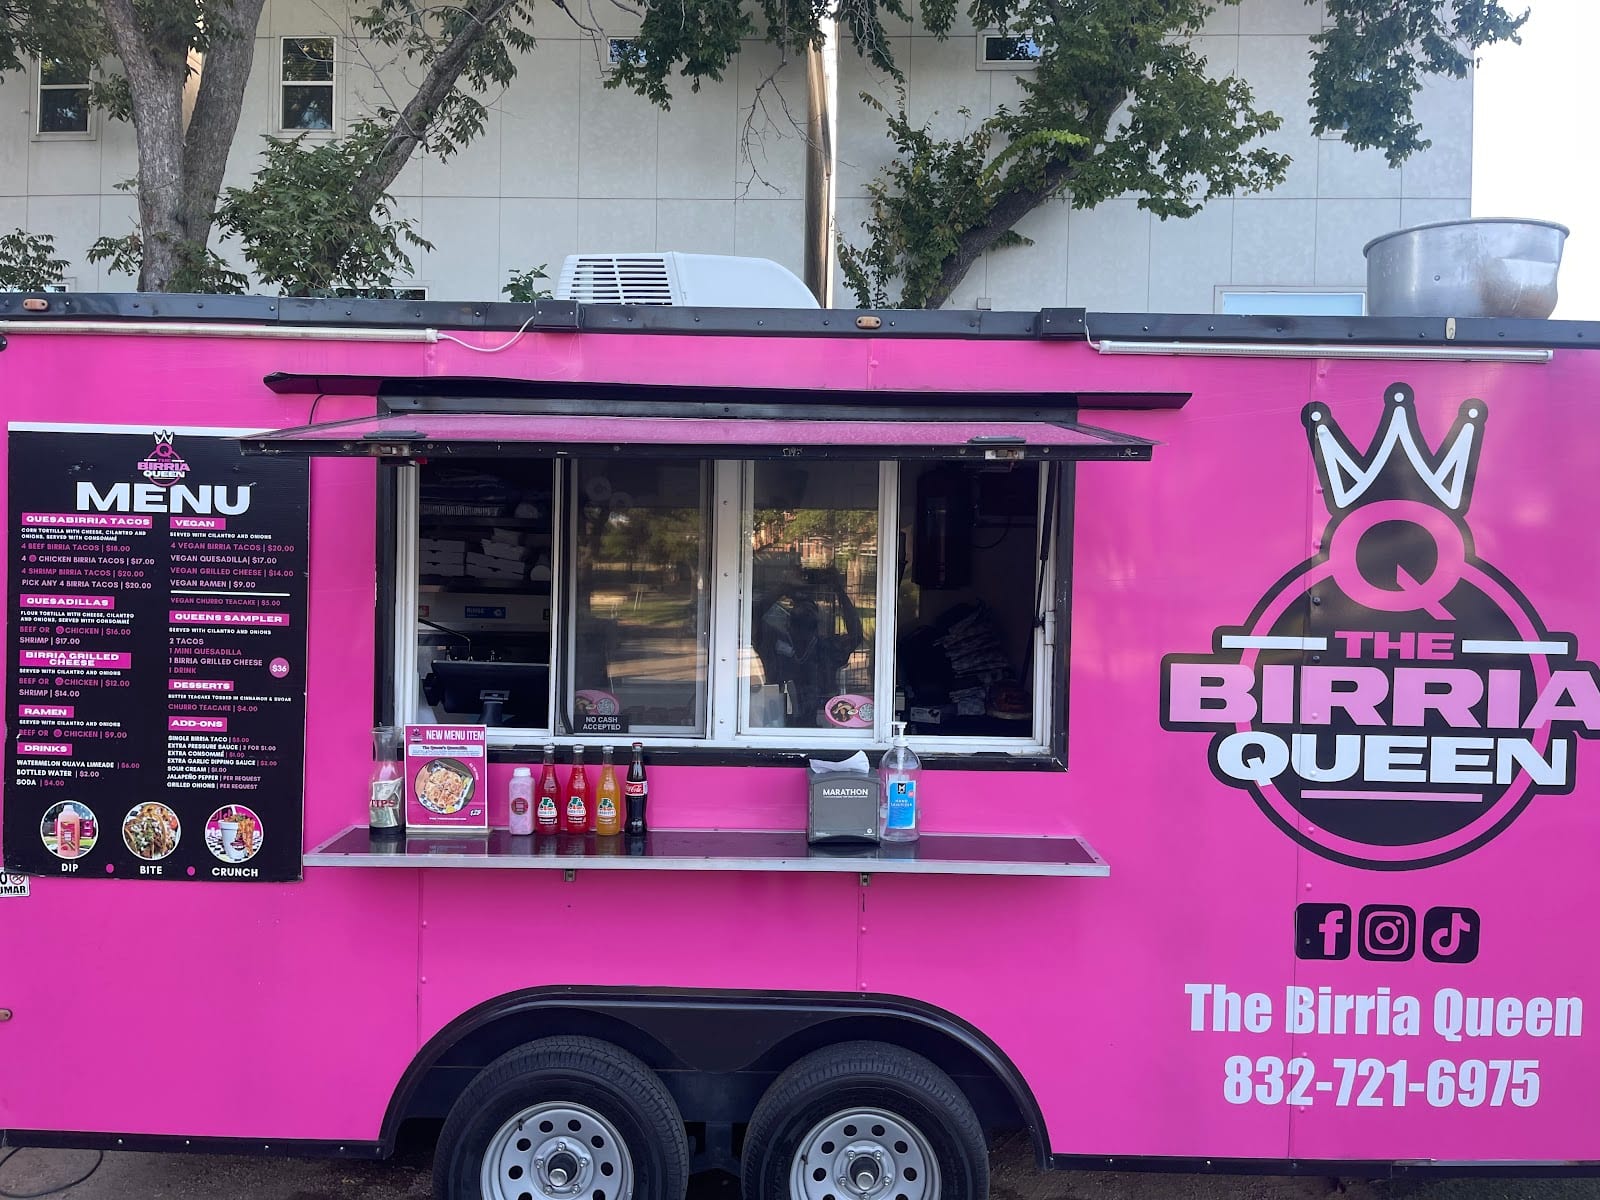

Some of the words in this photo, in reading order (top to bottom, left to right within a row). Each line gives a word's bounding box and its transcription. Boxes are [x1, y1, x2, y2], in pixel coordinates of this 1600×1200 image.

[137, 462, 190, 472] BIRRIA
[76, 482, 250, 516] MENU
[26, 516, 107, 524] QUESABIRRIA
[1329, 499, 1465, 620] Q
[27, 597, 108, 606] QUESADILLAS
[55, 637, 80, 645] $17.00
[1335, 631, 1454, 660] THE
[69, 653, 119, 661] GRILLED
[194, 648, 242, 656] QUESADILLA
[49, 659, 95, 667] CHEESE
[1169, 663, 1600, 730] BIRRIA
[426, 730, 442, 740] NEW
[444, 730, 465, 740] MENU
[466, 730, 484, 741] ITEM
[24, 744, 67, 753] DRINKS
[1216, 730, 1568, 786] QUEEN
[370, 799, 396, 808] TIPS
[62, 863, 78, 872] DIP
[140, 865, 162, 875] BITE
[212, 867, 258, 877] CRUNCH
[1184, 984, 1272, 1032] The
[1285, 986, 1420, 1036] Birria
[1434, 987, 1583, 1042] Queen
[1223, 1055, 1541, 1107] 832-721-6975
